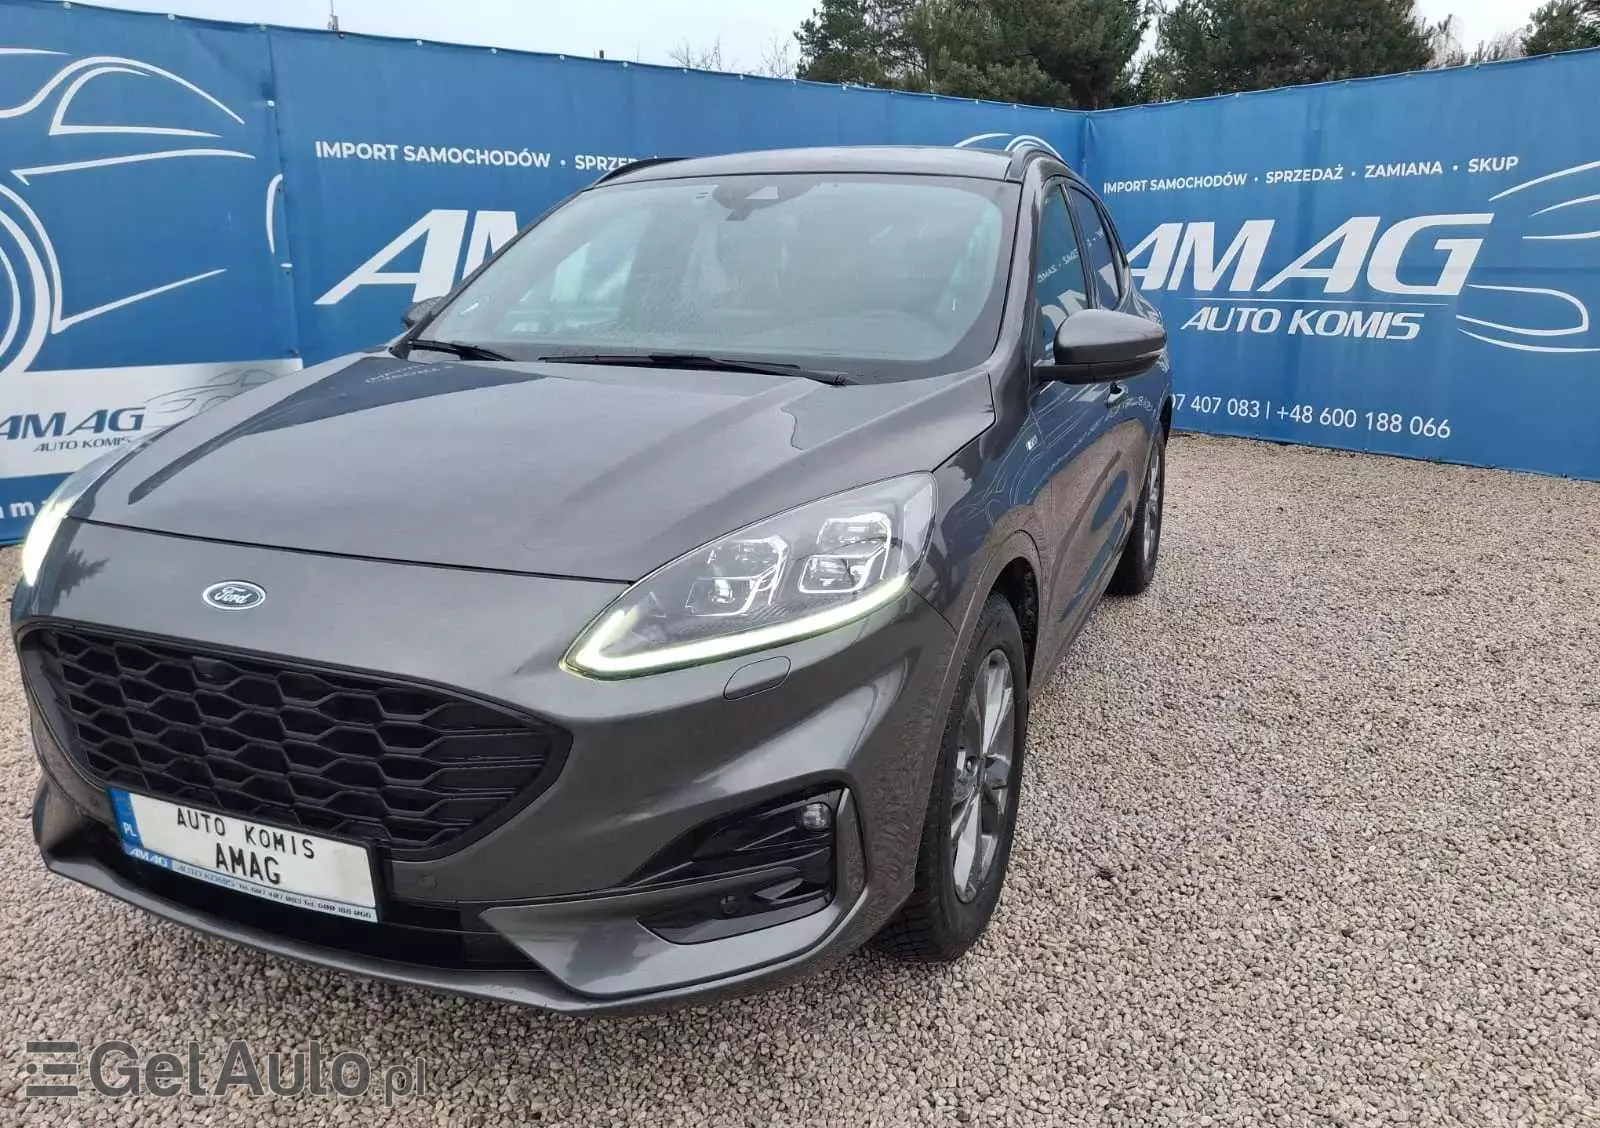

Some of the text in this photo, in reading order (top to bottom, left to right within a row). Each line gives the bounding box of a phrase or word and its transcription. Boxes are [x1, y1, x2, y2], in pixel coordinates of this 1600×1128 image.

[315, 141, 398, 160] IMPORT
[403, 145, 550, 168] SAMOCHODÓW
[1103, 156, 1519, 194] IMPORT SAMOCHODÓW SPRZEDAŻ ZAMIANA SKUP
[1181, 306, 1425, 341] AUTO KOMIS
[1190, 395, 1222, 414] 407
[1227, 398, 1260, 418] 083
[1276, 404, 1313, 424] +48
[1319, 407, 1357, 429] 600
[1365, 411, 1402, 433] 188
[1409, 415, 1451, 439] 066
[33, 440, 78, 453] AUTO
[214, 586, 253, 604] Ford
[122, 822, 137, 837] PL
[176, 807, 315, 860] AUTO KOMIS
[215, 842, 281, 885] AMAG
